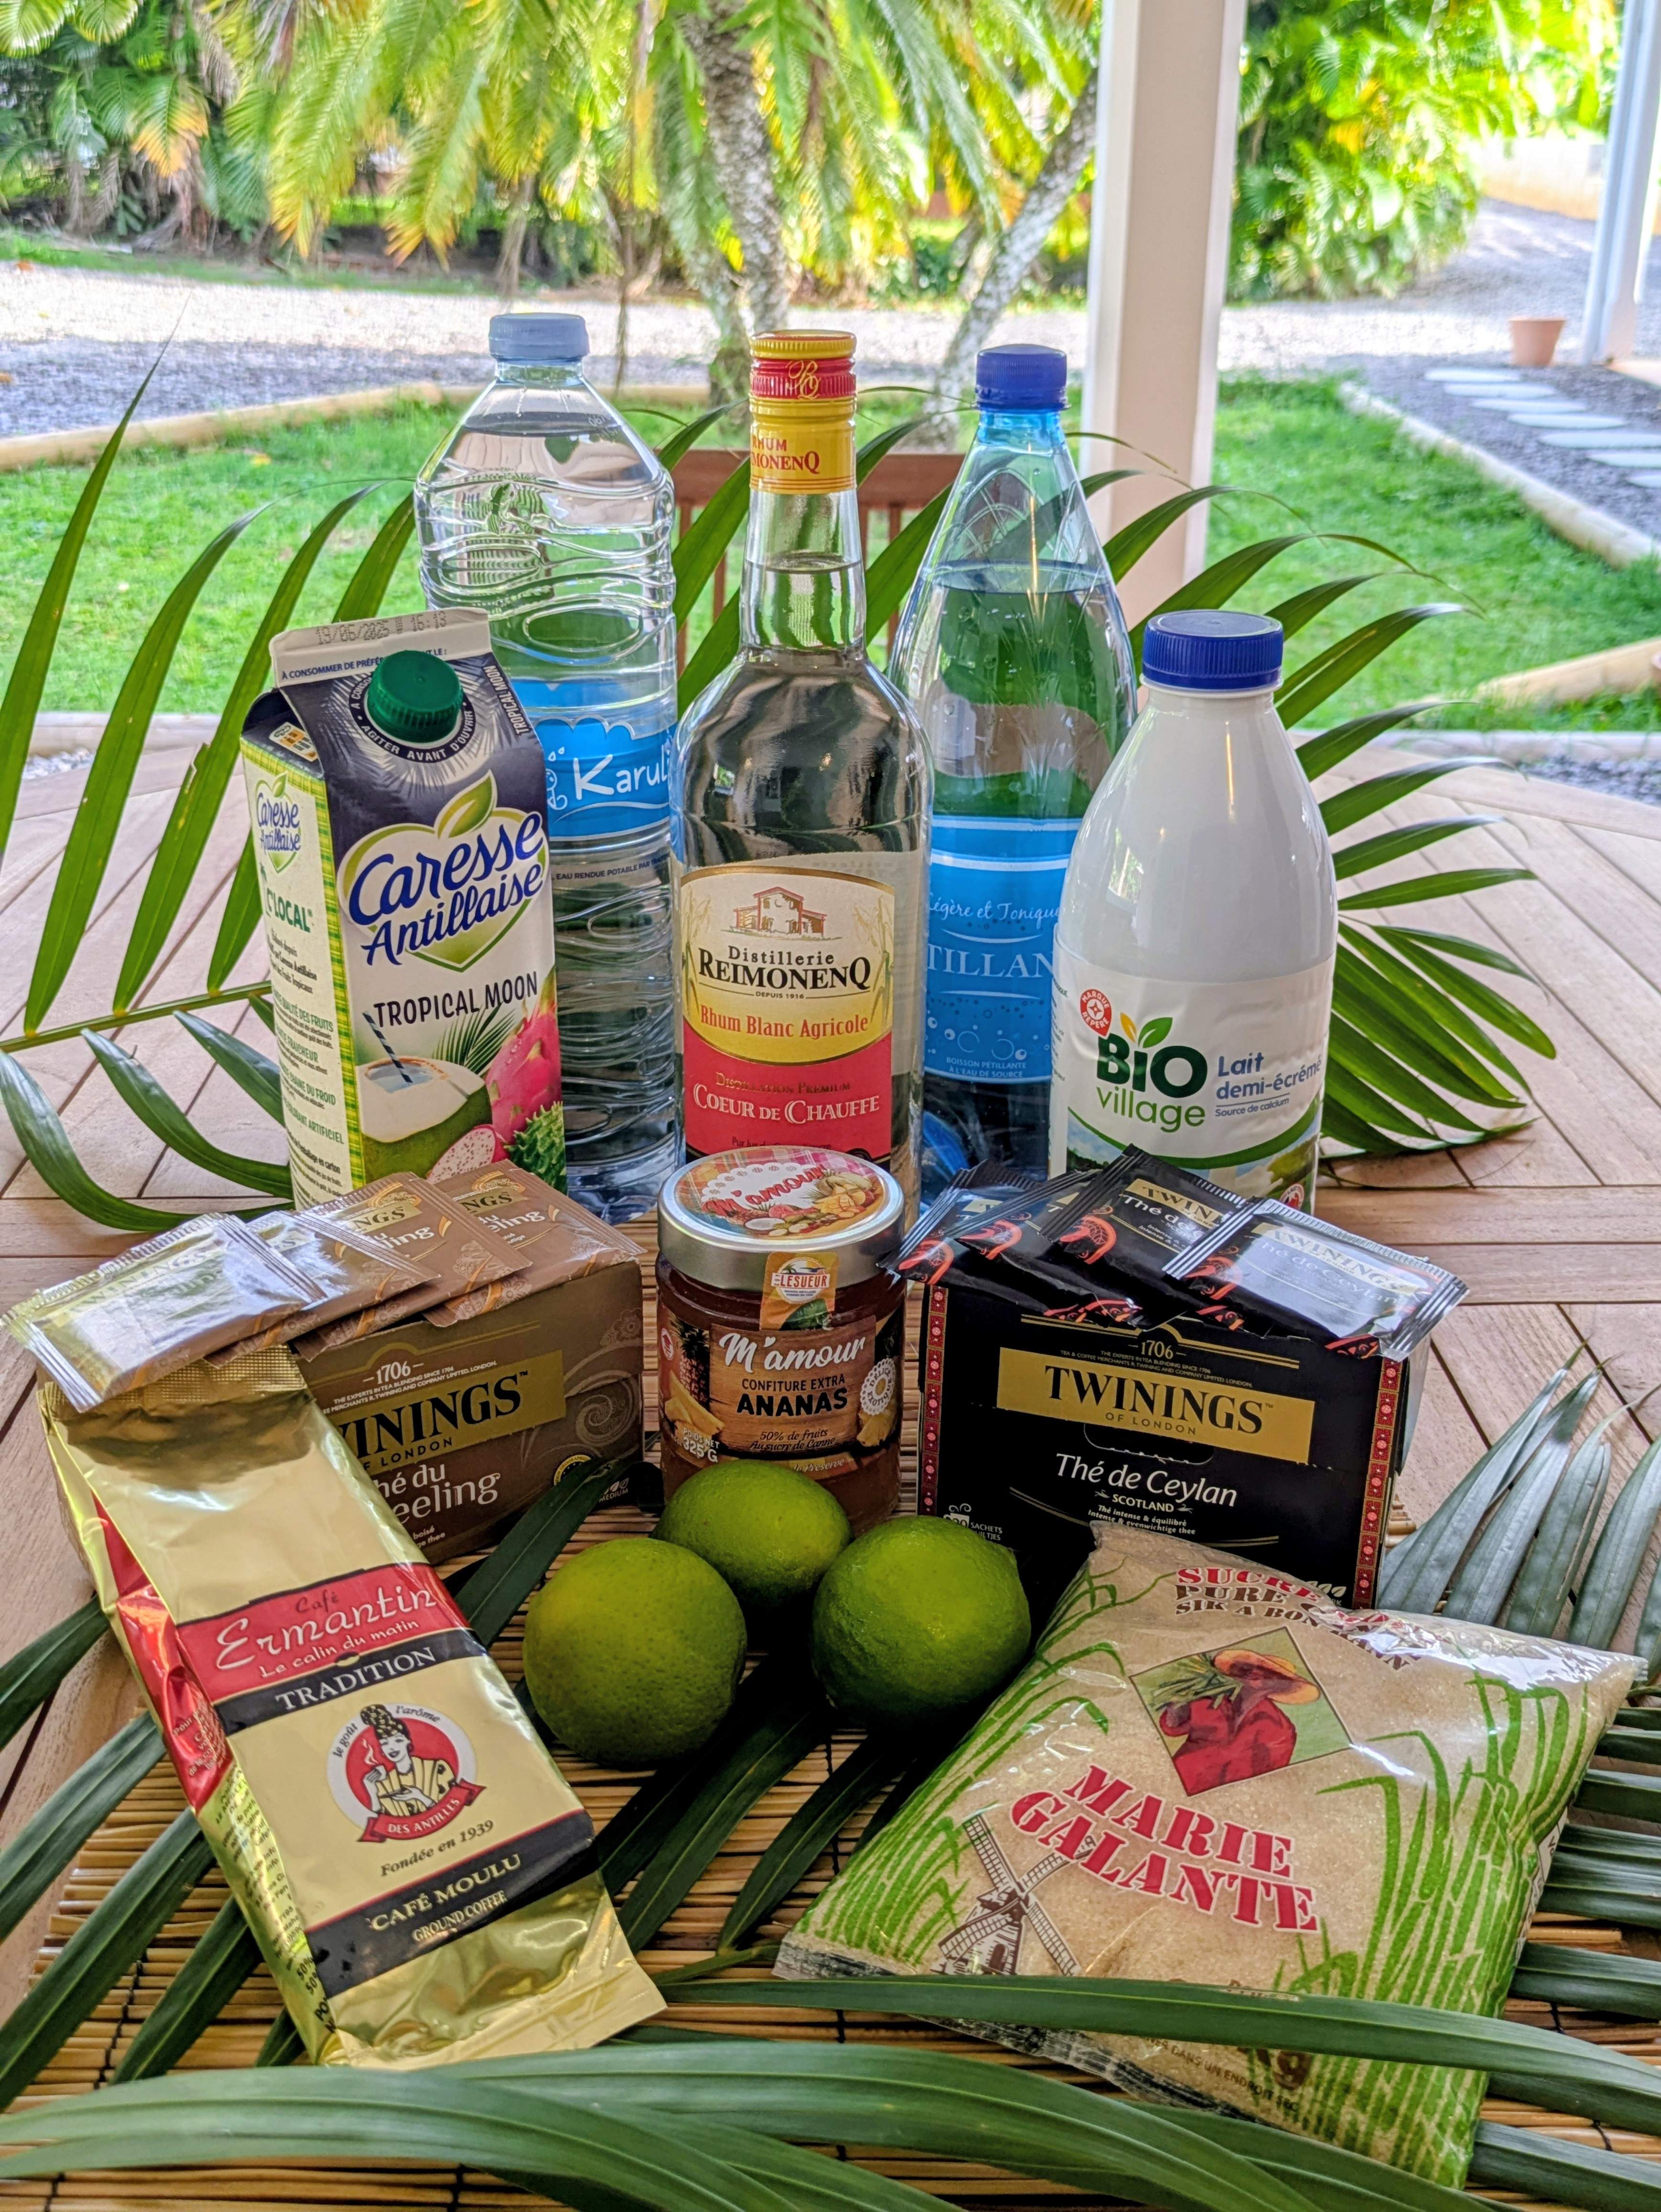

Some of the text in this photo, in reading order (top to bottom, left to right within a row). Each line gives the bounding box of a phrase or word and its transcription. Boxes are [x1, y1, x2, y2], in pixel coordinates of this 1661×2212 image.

[752, 435, 787, 452] RHUM
[289, 663, 343, 678] CONSOMMER
[343, 661, 355, 669] DE
[356, 656, 385, 668] PRÉFÉ
[484, 665, 530, 735] TROPICAL MOON
[361, 710, 473, 762] AGITER AVANT D'OUVRIR
[573, 744, 670, 800] Karul
[257, 792, 300, 829] Caresse
[260, 827, 301, 853] Antillaise
[348, 813, 544, 926] Caresse
[575, 871, 605, 879] RENDUE
[607, 864, 637, 876] POTABLE
[639, 862, 651, 870] PAR
[361, 862, 544, 966] Antillaise
[977, 901, 993, 919] et
[698, 948, 871, 991] REIMONENQ
[728, 945, 835, 966] Distillerie
[928, 943, 1053, 978] TILLAN
[374, 971, 538, 1028] TROPICAL MOON
[755, 991, 784, 999] DEPUIS
[1082, 991, 1110, 1008] MARQUE
[310, 1014, 334, 1033] FRUITS
[700, 1004, 869, 1040] Rhum Blanc Agricole
[946, 1057, 980, 1067] BOISSON
[1217, 1052, 1264, 1077] Lait
[1216, 1055, 1322, 1100] demi-écrémé
[315, 1088, 336, 1106] FROID
[693, 1083, 879, 1124] COEUR DE CHAUFFE
[1096, 1085, 1206, 1132] village
[1214, 1096, 1290, 1117] Source de calcium
[308, 1119, 344, 1145] ARTIFICIEL
[700, 1164, 826, 1217] M'amour
[1118, 1194, 1163, 1215] Thé
[1273, 1230, 1406, 1292] TWININGS
[780, 1274, 827, 1288] LESUEUR
[719, 1332, 866, 1373] M'amour
[1112, 1351, 1135, 1360] EXPERTS
[1153, 1359, 1181, 1369] BLENDING
[1141, 1340, 1174, 1360] 1706
[376, 1360, 411, 1385] 1706
[1077, 1353, 1096, 1361] COFFEE
[1097, 1356, 1130, 1366] MERCHANTS
[1136, 1362, 1161, 1371] TWINING
[1162, 1365, 1175, 1373] AND
[1175, 1368, 1203, 1379] COMPANY
[331, 1398, 368, 1412] MERCHANTS
[375, 1388, 402, 1400] TWINING
[402, 1382, 416, 1391] AND
[417, 1374, 446, 1387] COMPANY
[346, 1369, 441, 1401] EXPERTS TEA BLENDING SINCE
[742, 1373, 845, 1391] CONFITURE EXTRA
[737, 1388, 848, 1417] ANANAS
[683, 1427, 703, 1443] POIDS
[705, 1436, 720, 1449] NET
[760, 1428, 828, 1441] 50% de fruits
[1106, 1412, 1196, 1436] OF LONDON
[381, 1437, 454, 1469] LONDON
[683, 1437, 705, 1459] 325
[707, 1449, 719, 1463] G
[765, 1437, 836, 1451] sucre de Canne
[373, 1463, 446, 1498] hé du
[1056, 1453, 1238, 1507] Thé de Ceylan
[392, 1472, 501, 1524] eeling
[1112, 1493, 1174, 1513] SCOTLAND
[970, 1522, 1003, 1534] SACHETS
[1087, 1509, 1116, 1522] Intense
[1126, 1520, 1177, 1534] evenwichtige
[1098, 1504, 1111, 1514] Thé
[1113, 1508, 1141, 1521] intense
[1151, 1515, 1187, 1527] équilibré
[413, 1525, 435, 1540] boisé
[428, 1532, 446, 1544] thee
[1174, 1583, 1288, 1605] PURE
[1176, 1567, 1323, 1603] SUCRE
[295, 1590, 339, 1614] Café
[1174, 1599, 1320, 1627] SIK A BON
[215, 1584, 437, 1671] Ermantin
[260, 1618, 420, 1679] Le calin du matin
[274, 1647, 438, 1711] TRADITION
[396, 1705, 441, 1723] l'arôme
[332, 1723, 359, 1758] le goût
[388, 1798, 461, 1834] DES ANTILLES
[1061, 1764, 1295, 1879] MARIE
[380, 1819, 494, 1877] Fondée en 1939
[1010, 1791, 1321, 1934] GALANTE
[370, 1853, 522, 1931] CAFÉ MOULU
[411, 1890, 508, 1943] GROUND COFFEE
[1170, 2044, 1202, 2067] DANS
[1204, 2060, 1220, 2077] UN
[1223, 2069, 1274, 2101] ENDROIT
